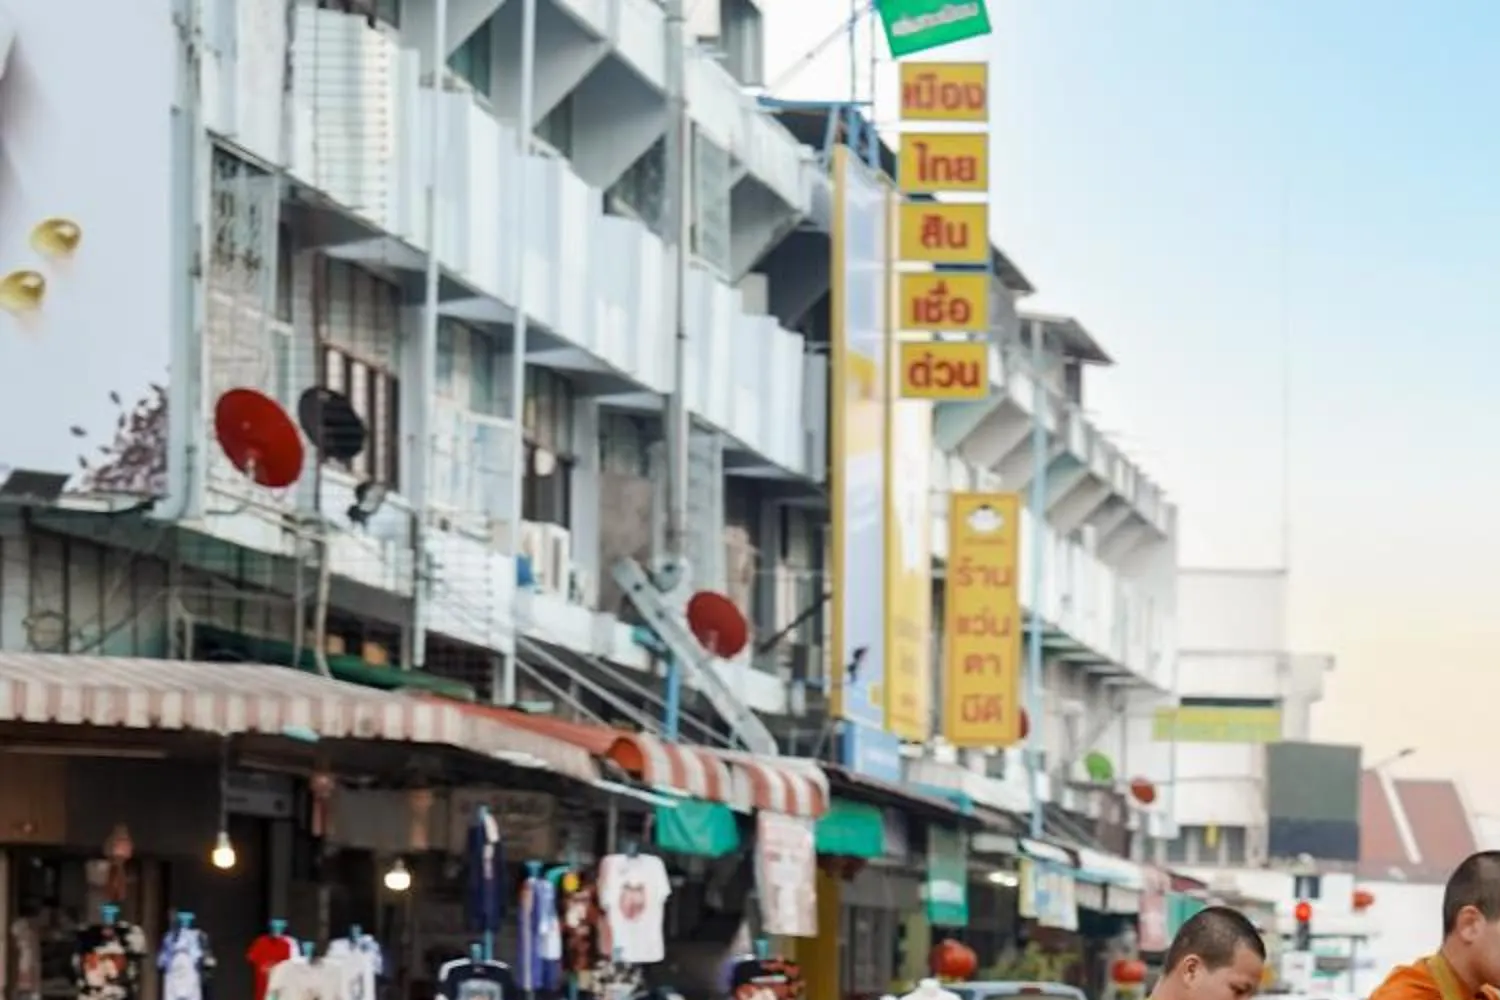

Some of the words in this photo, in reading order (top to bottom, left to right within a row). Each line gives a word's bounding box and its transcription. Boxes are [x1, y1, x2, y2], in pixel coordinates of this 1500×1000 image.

[912, 140, 977, 182] ไทย
[912, 279, 971, 324] เชื่อ
[908, 352, 980, 388] ด่วน
